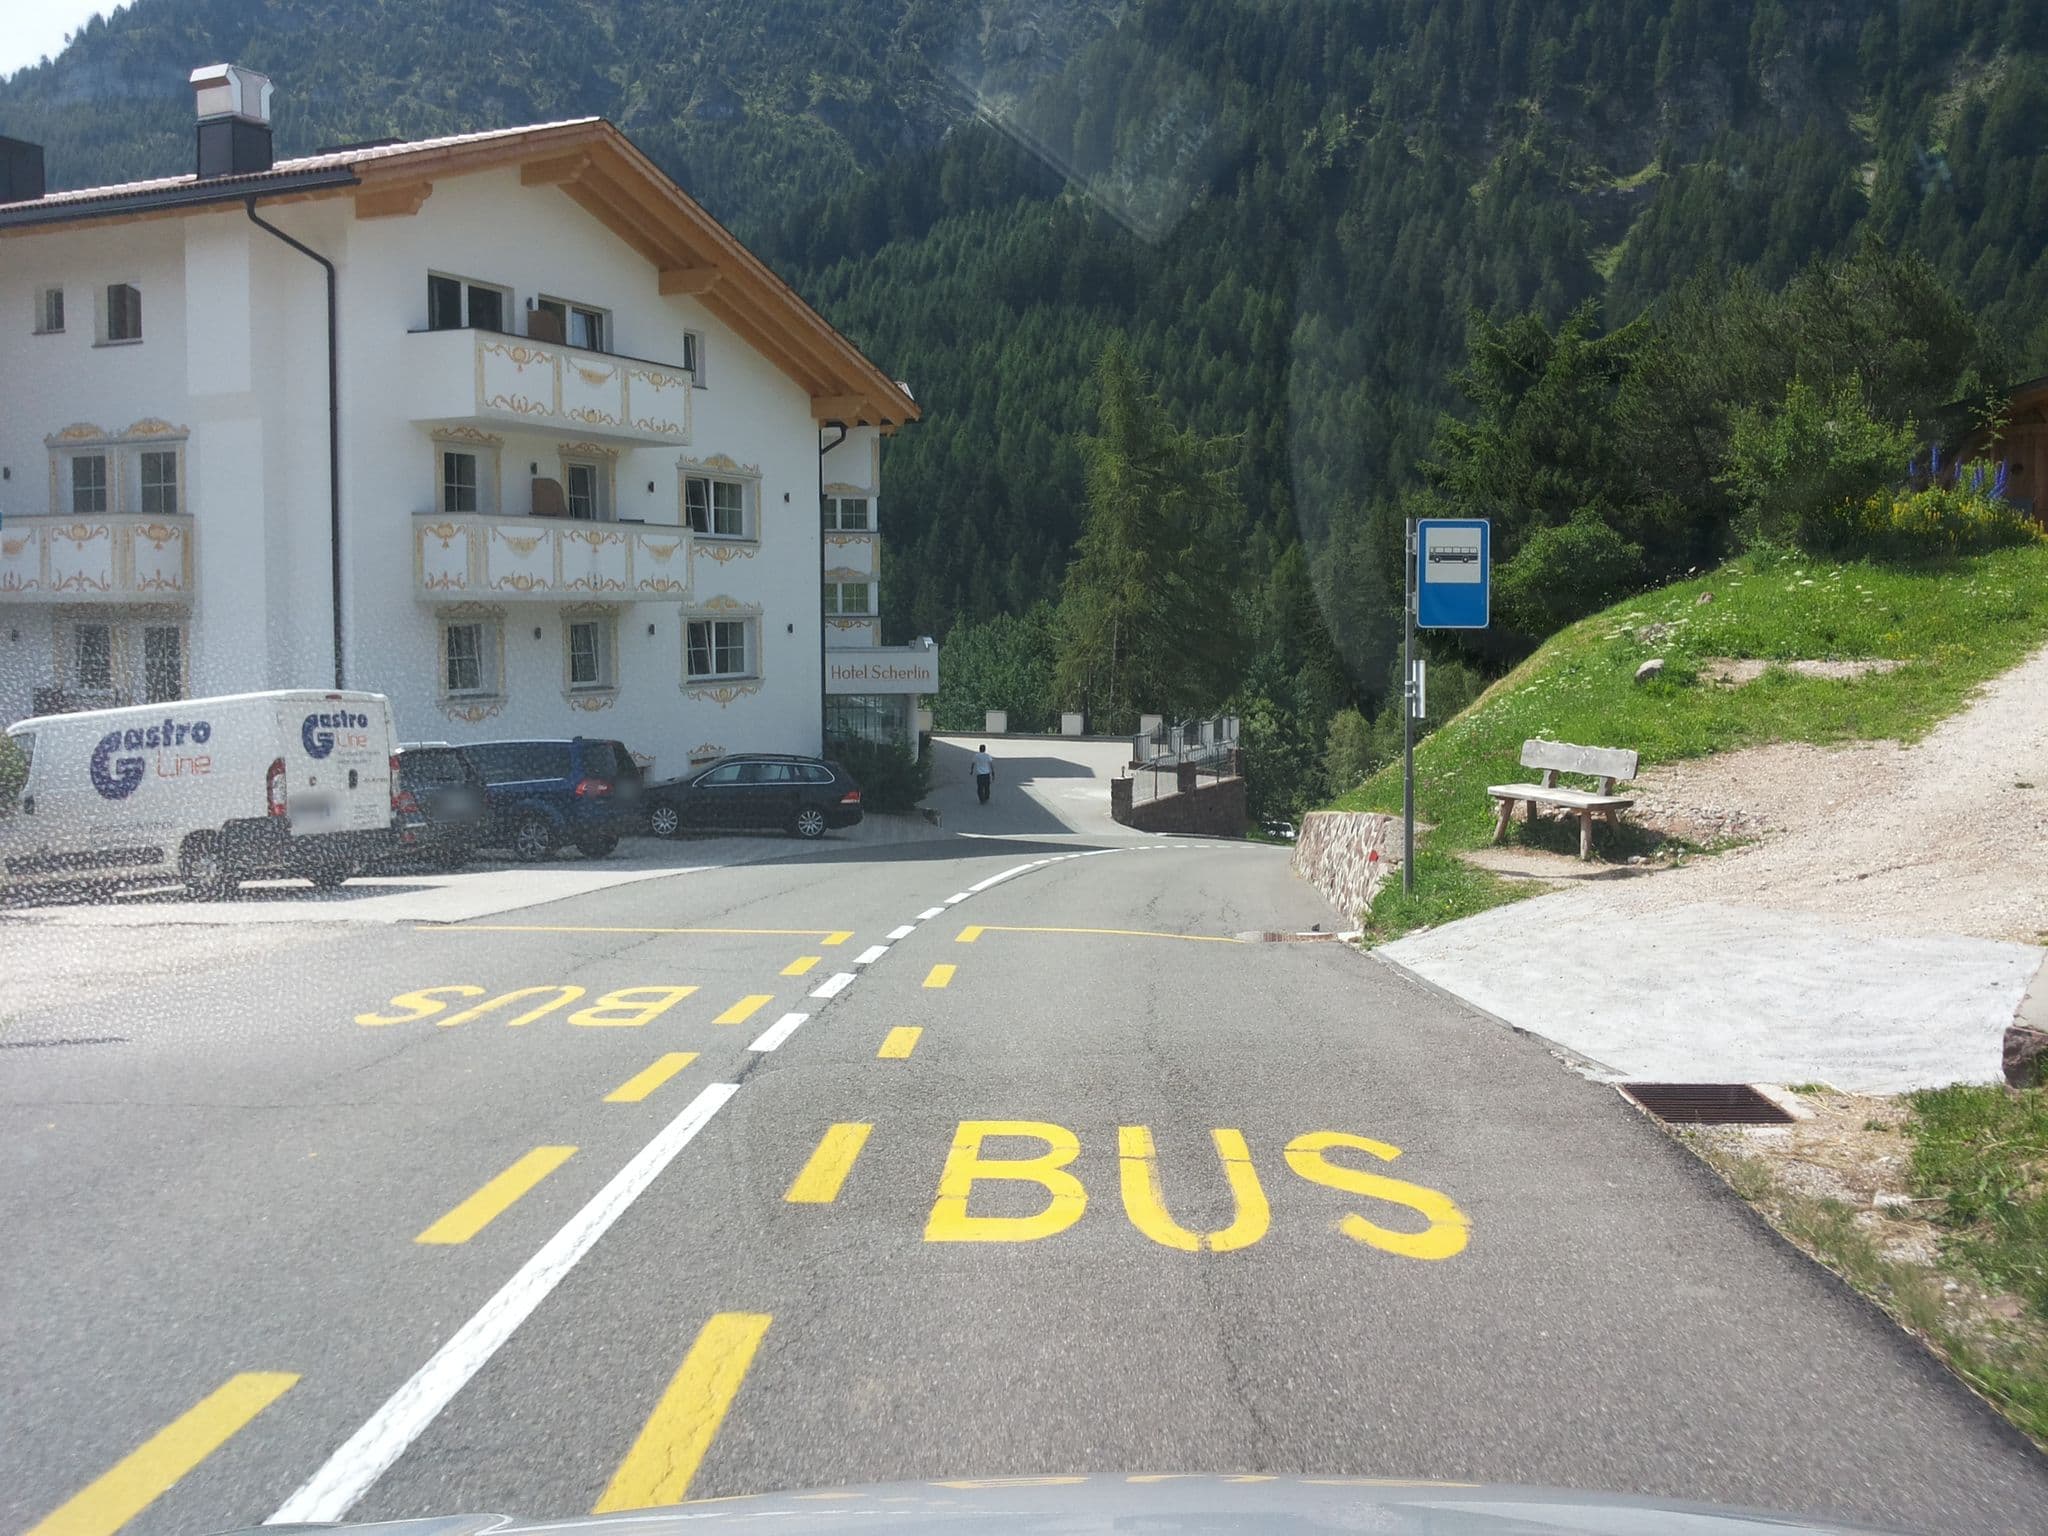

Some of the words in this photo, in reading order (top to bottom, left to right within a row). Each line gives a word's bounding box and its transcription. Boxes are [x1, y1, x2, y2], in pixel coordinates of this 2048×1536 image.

[831, 664, 867, 680] Hotel
[871, 664, 930, 680] Scherlin
[302, 709, 368, 759] Gastro
[337, 732, 368, 748] Line
[90, 719, 211, 800] Gastro
[157, 751, 211, 778] Line
[354, 985, 700, 1027] BUS
[924, 1120, 1471, 1260] BUS
